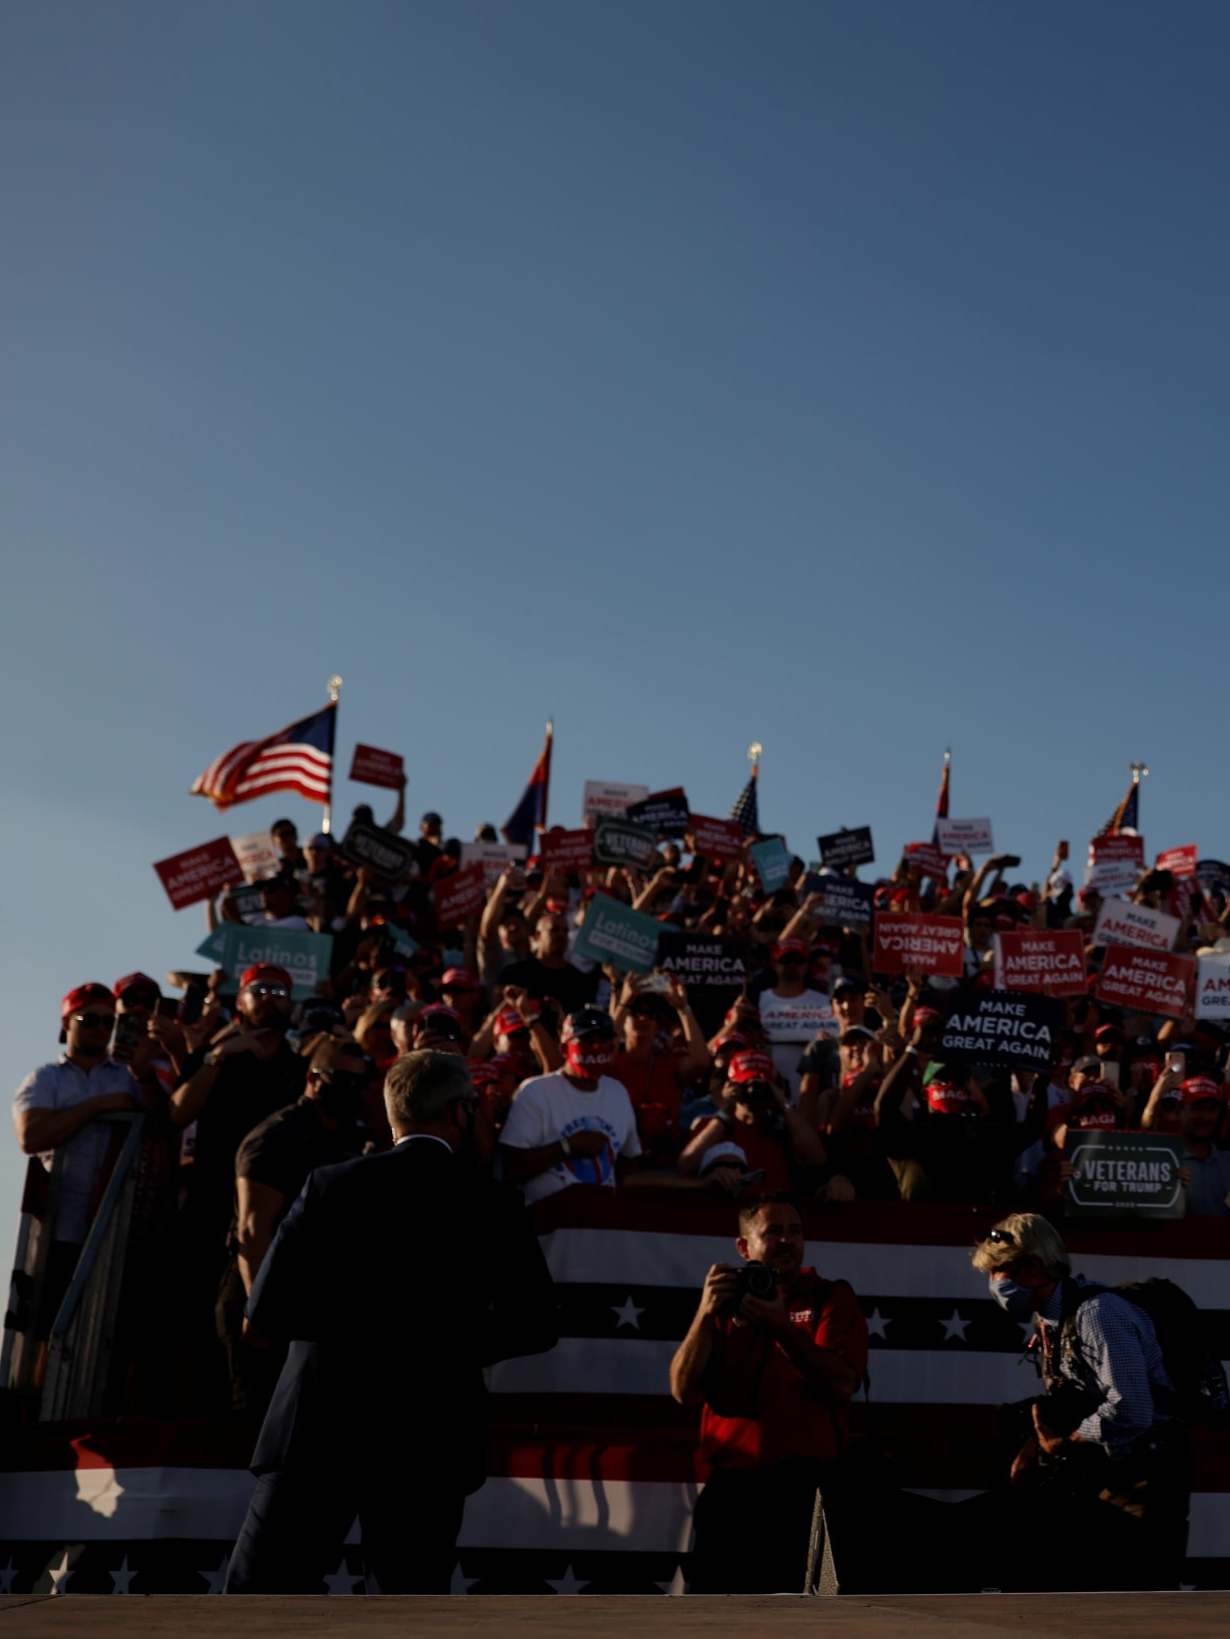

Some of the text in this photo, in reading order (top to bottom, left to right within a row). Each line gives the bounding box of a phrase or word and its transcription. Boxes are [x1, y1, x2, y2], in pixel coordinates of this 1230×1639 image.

[1103, 919, 1169, 947] AMERICA
[237, 941, 317, 967] Latinos
[686, 944, 723, 956] MAKE
[879, 935, 961, 956] AMERICA
[1021, 940, 1057, 952] MAKE
[662, 956, 745, 973] AMERICA
[1006, 953, 1082, 971] AMERICA
[1131, 956, 1168, 973] MAKE
[1007, 971, 1084, 986] GREAT AGAIN
[1105, 964, 1186, 995] AMERICA
[1101, 980, 1185, 1008] GREAT AGAIN
[979, 1000, 1027, 1017] MAKE
[945, 1013, 1052, 1044] AMERICA
[942, 1034, 1052, 1061] GREAT AGAIN
[1085, 1160, 1171, 1182] VETERANS
[1093, 1181, 1162, 1193] FOR TRUMP
